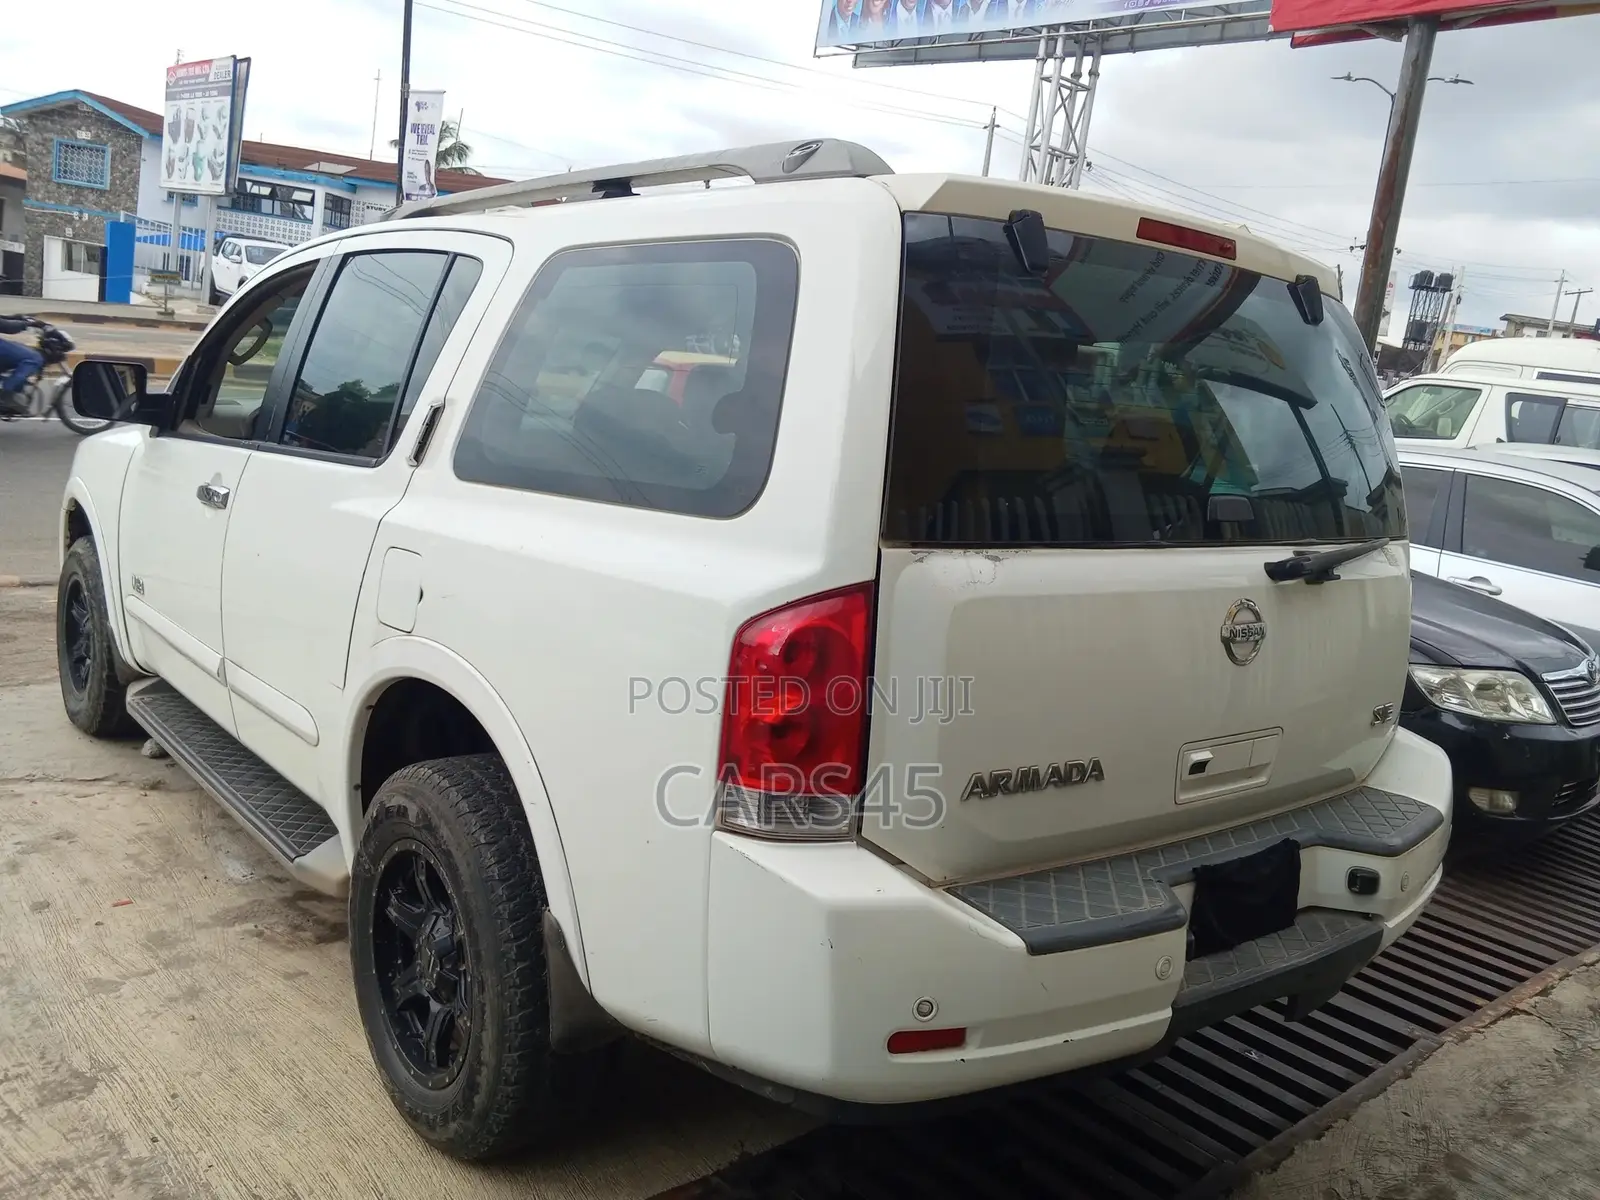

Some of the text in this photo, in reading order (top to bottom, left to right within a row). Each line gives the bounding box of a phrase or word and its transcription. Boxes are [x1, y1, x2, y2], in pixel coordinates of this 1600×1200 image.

[1228, 626, 1265, 640] NISSAN
[1371, 701, 1394, 727] SE
[960, 756, 1105, 801] ARMADA
